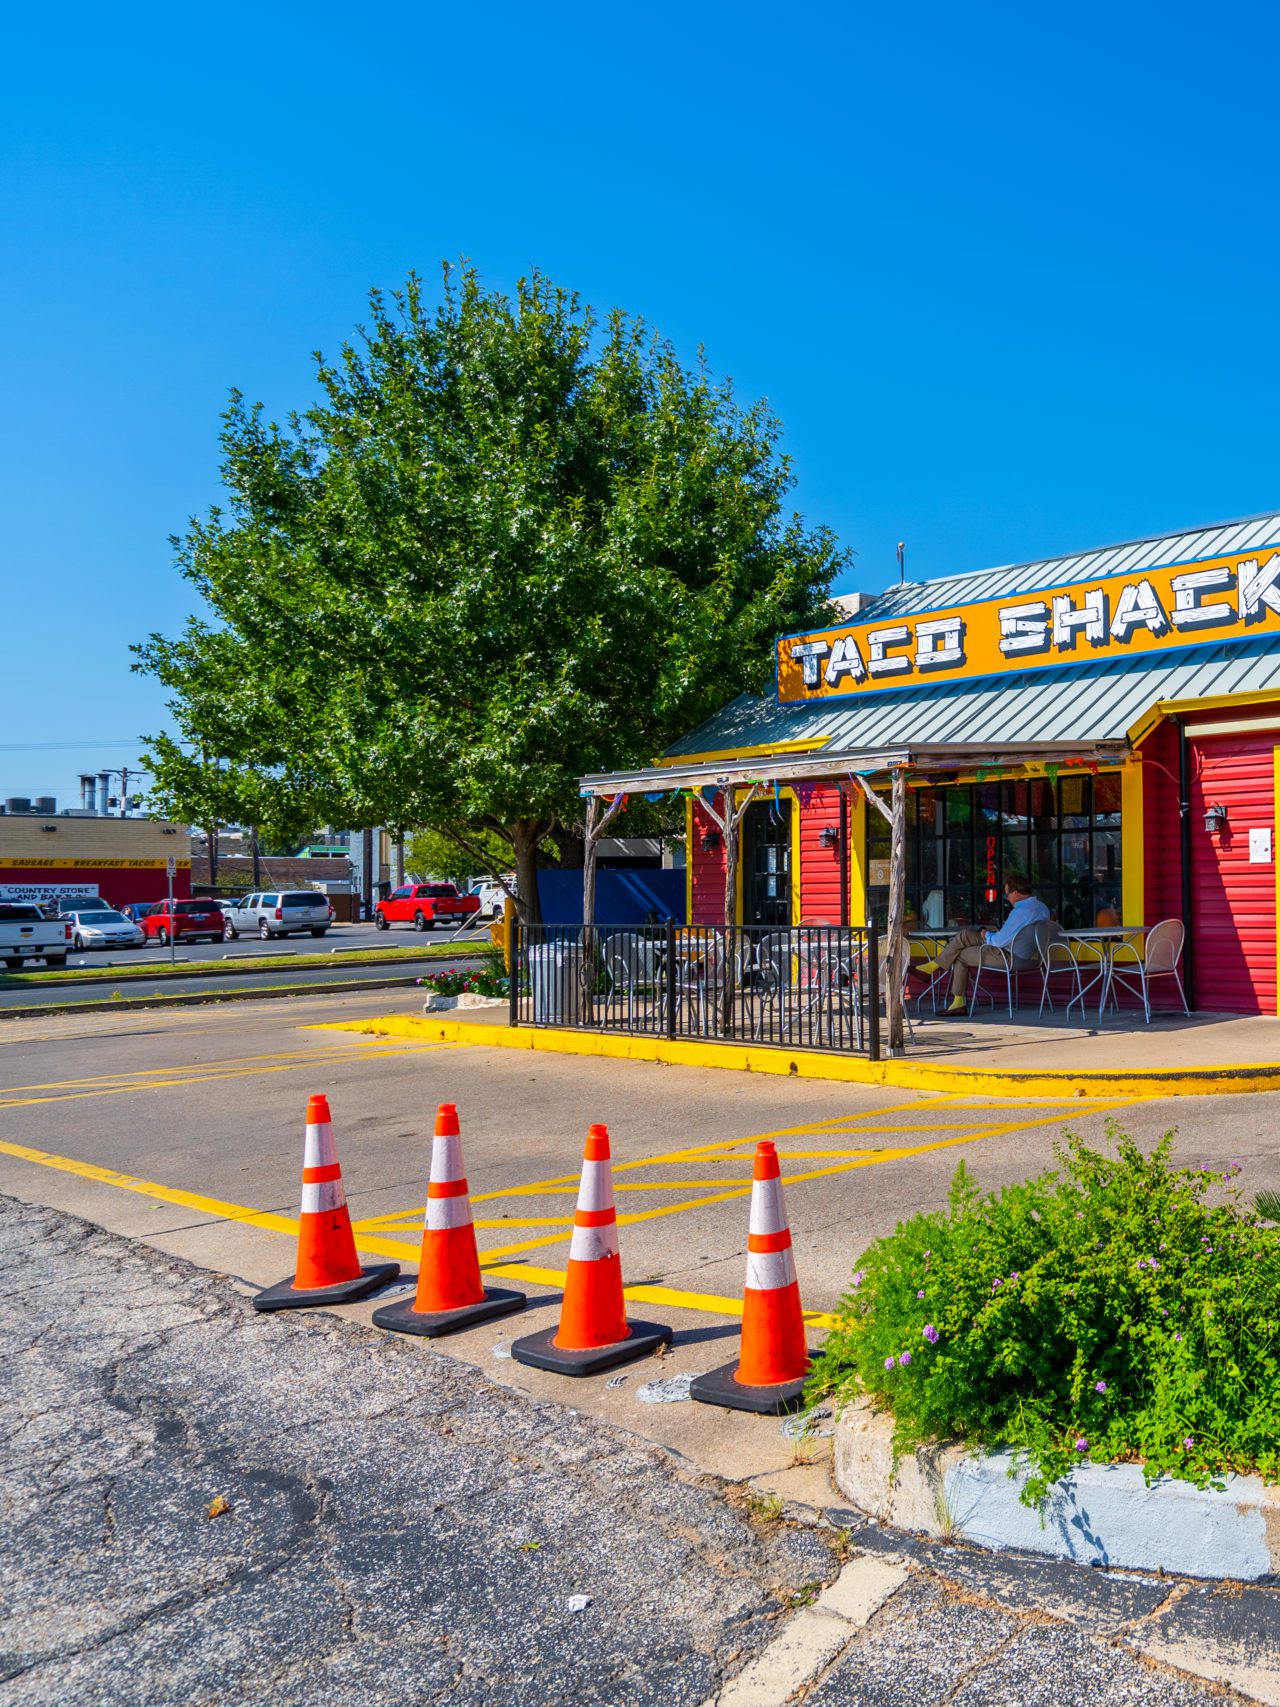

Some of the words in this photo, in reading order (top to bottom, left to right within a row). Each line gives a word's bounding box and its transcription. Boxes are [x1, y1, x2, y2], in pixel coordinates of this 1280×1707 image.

[791, 615, 967, 690] TACO
[11, 859, 55, 867] SAUSAGE
[73, 859, 124, 867] BREAKFAST
[128, 859, 156, 867] TACOS
[985, 835, 996, 886] OPEN
